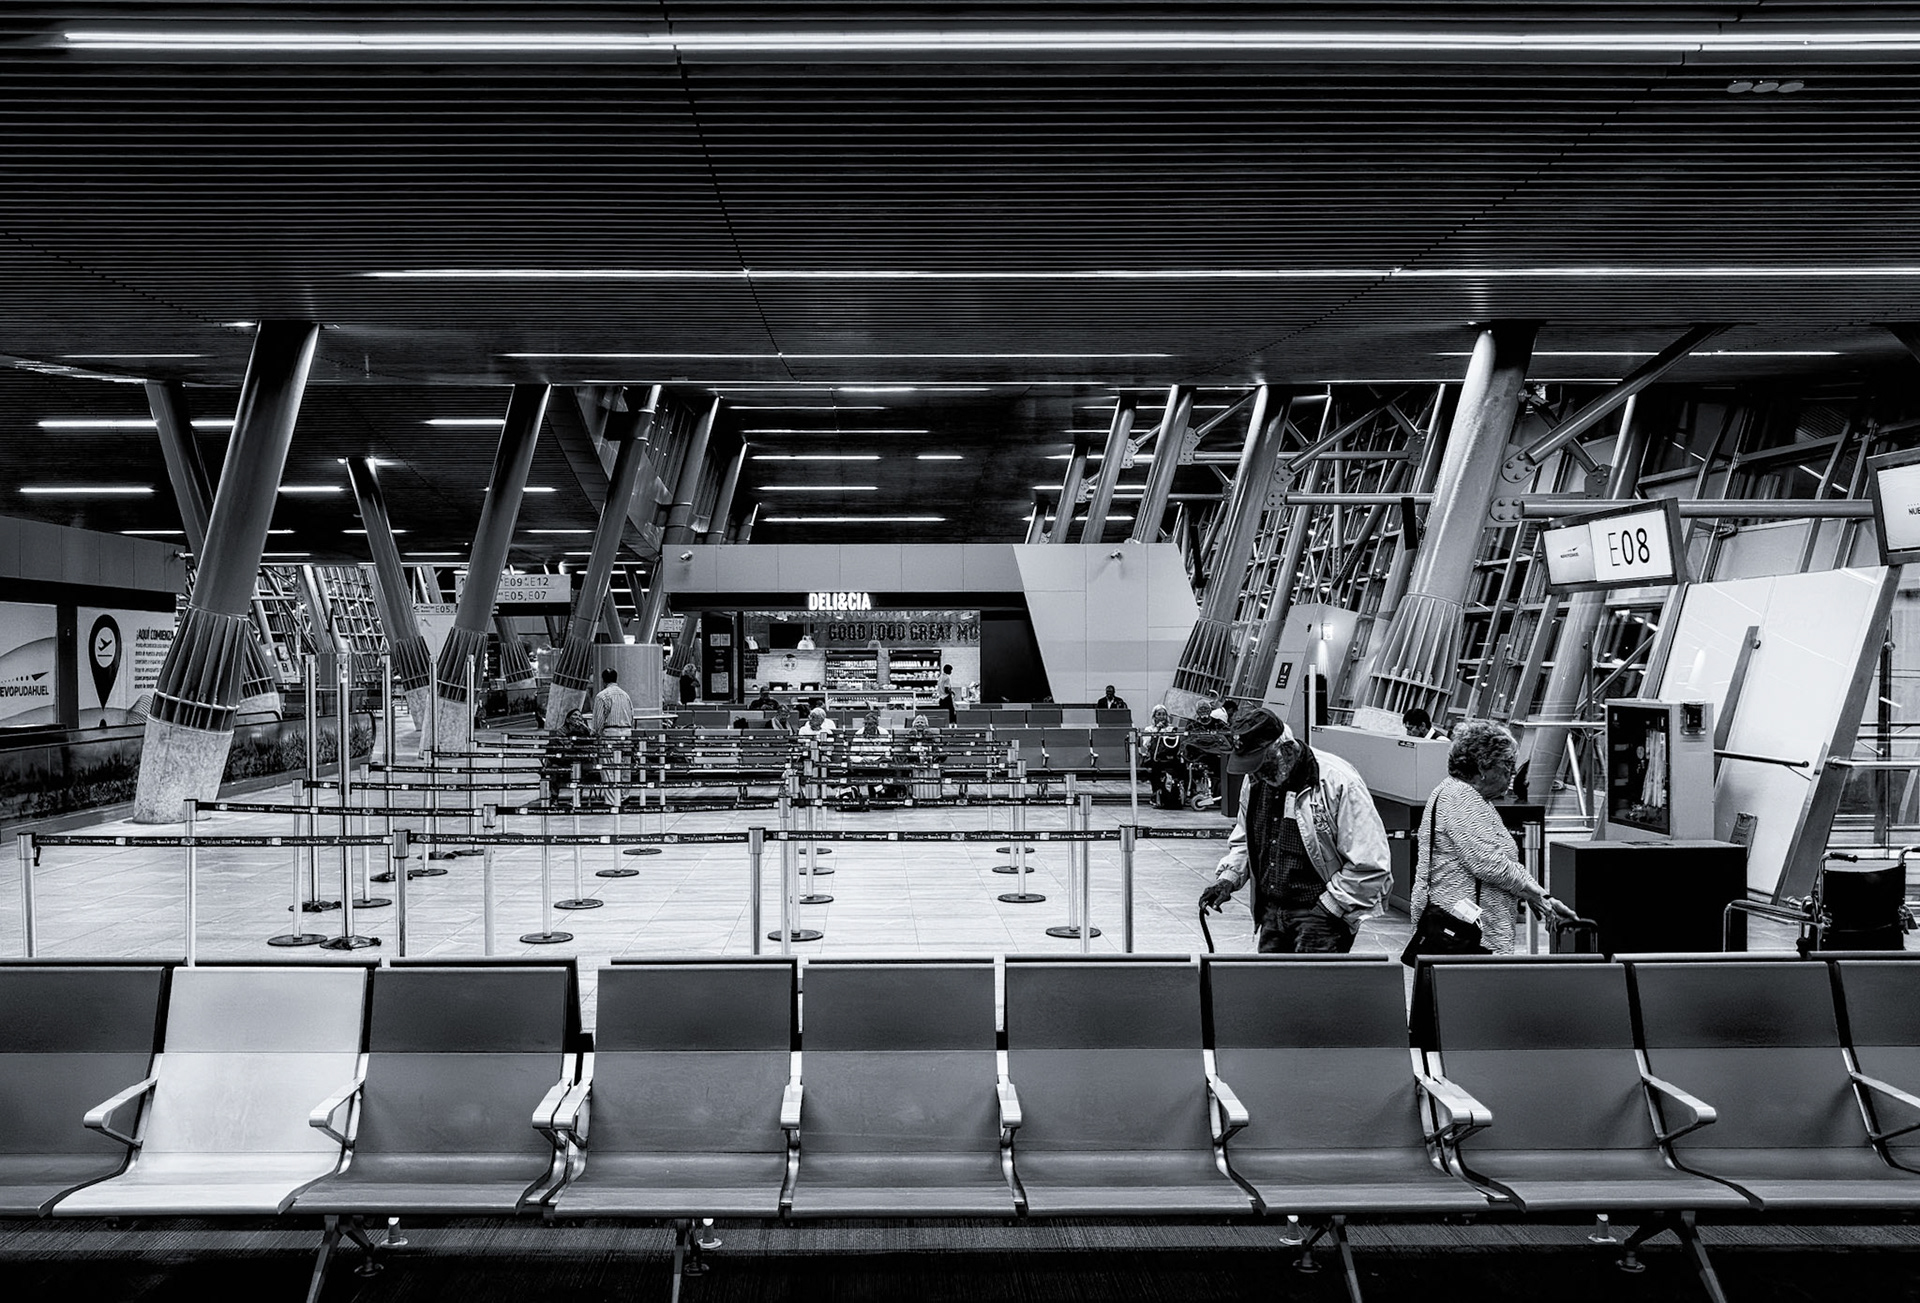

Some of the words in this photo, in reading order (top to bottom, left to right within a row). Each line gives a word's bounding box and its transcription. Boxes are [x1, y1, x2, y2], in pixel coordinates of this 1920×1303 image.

[1608, 528, 1650, 566] E08
[504, 578, 523, 587] E09
[530, 577, 549, 587] E12
[528, 591, 547, 600] E07
[808, 592, 872, 611] DELI&CIA
[828, 622, 866, 641] GOOD
